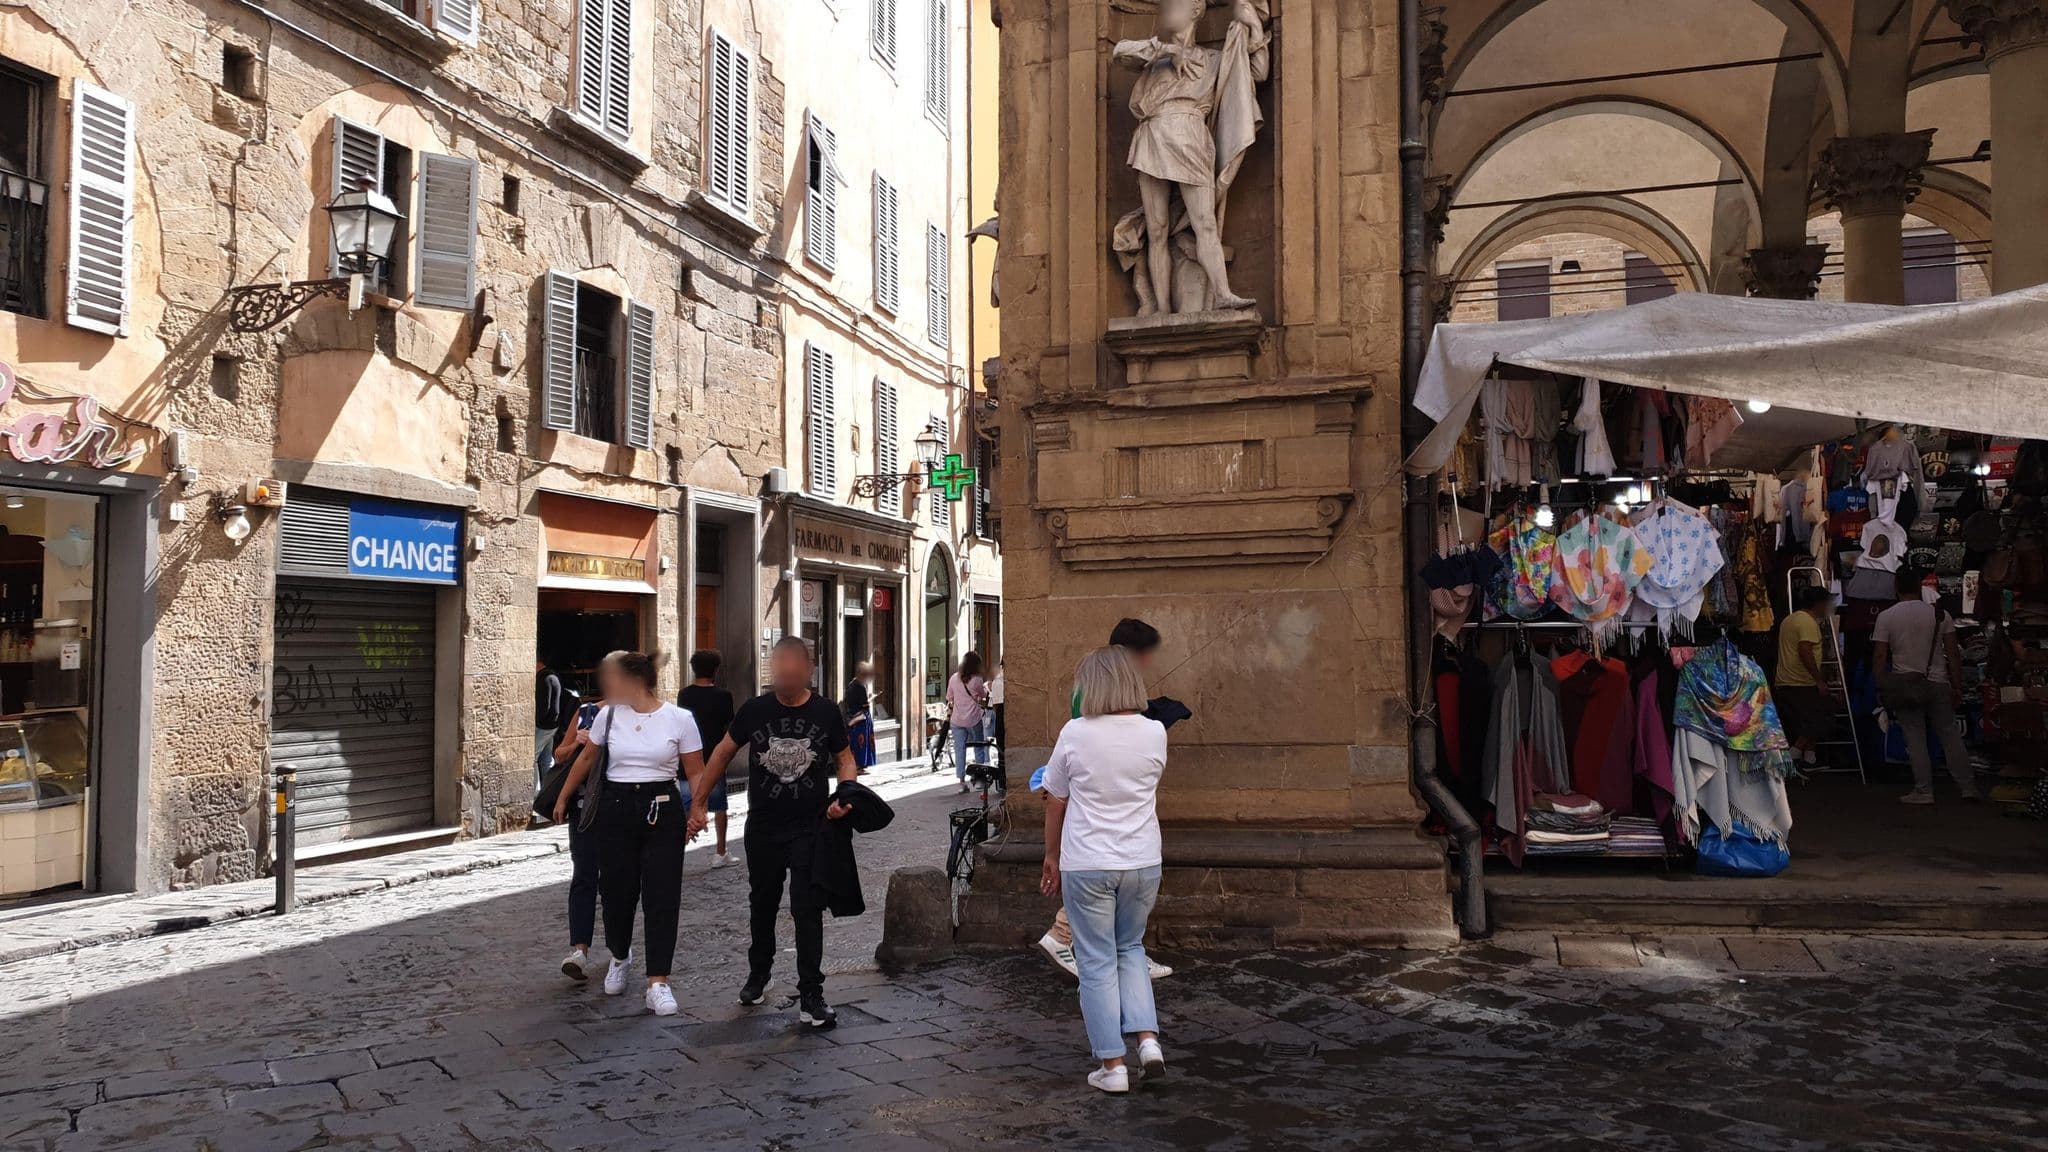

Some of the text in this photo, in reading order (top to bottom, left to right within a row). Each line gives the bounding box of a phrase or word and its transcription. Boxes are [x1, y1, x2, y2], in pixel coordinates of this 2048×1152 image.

[0, 361, 147, 468] ar
[1919, 451, 1950, 465] TALI
[351, 535, 457, 573] CHANGE
[794, 527, 907, 566] FARMACIA DEL CINGHIALE
[752, 717, 828, 747] DIESEL
